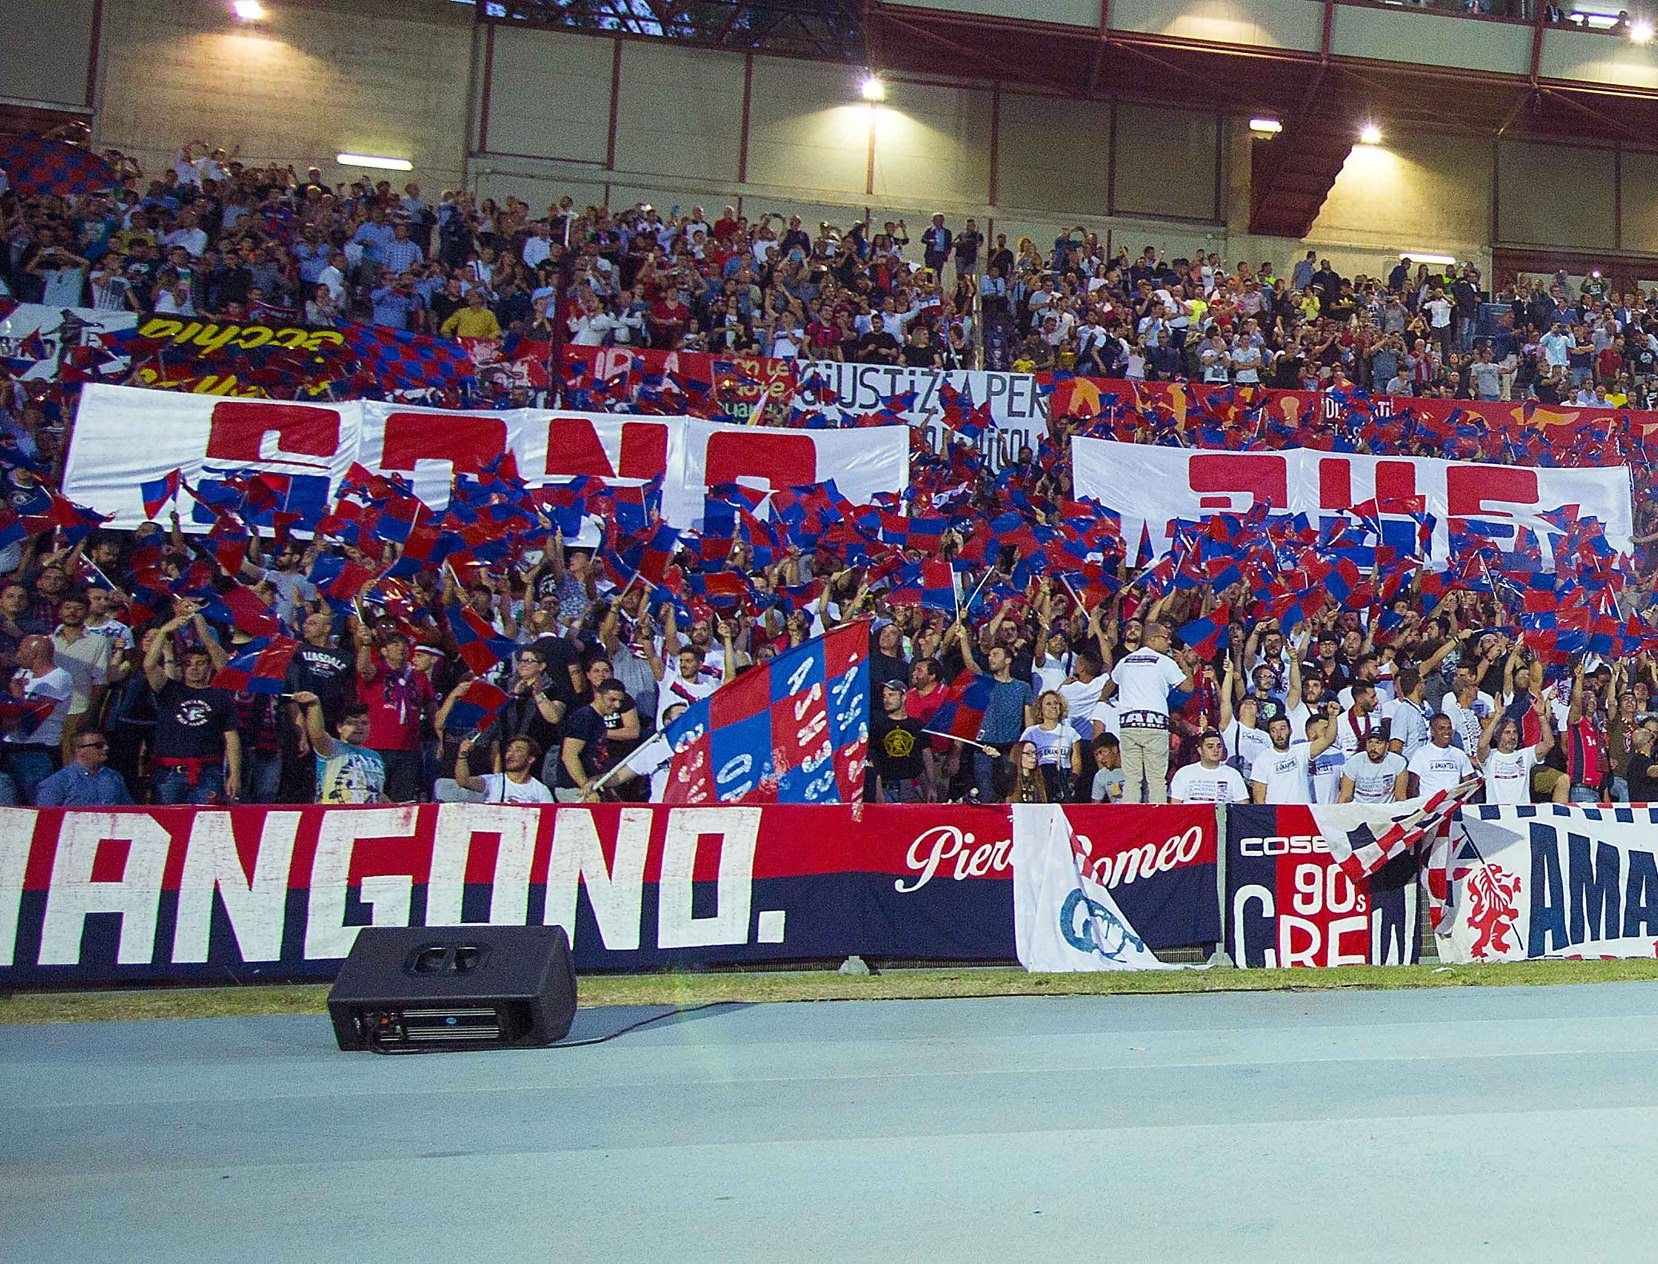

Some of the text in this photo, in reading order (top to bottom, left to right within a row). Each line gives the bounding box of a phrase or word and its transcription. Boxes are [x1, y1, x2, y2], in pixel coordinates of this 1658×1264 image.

[895, 825, 1203, 893] Pier omeo
[1240, 835, 1330, 857] COSE
